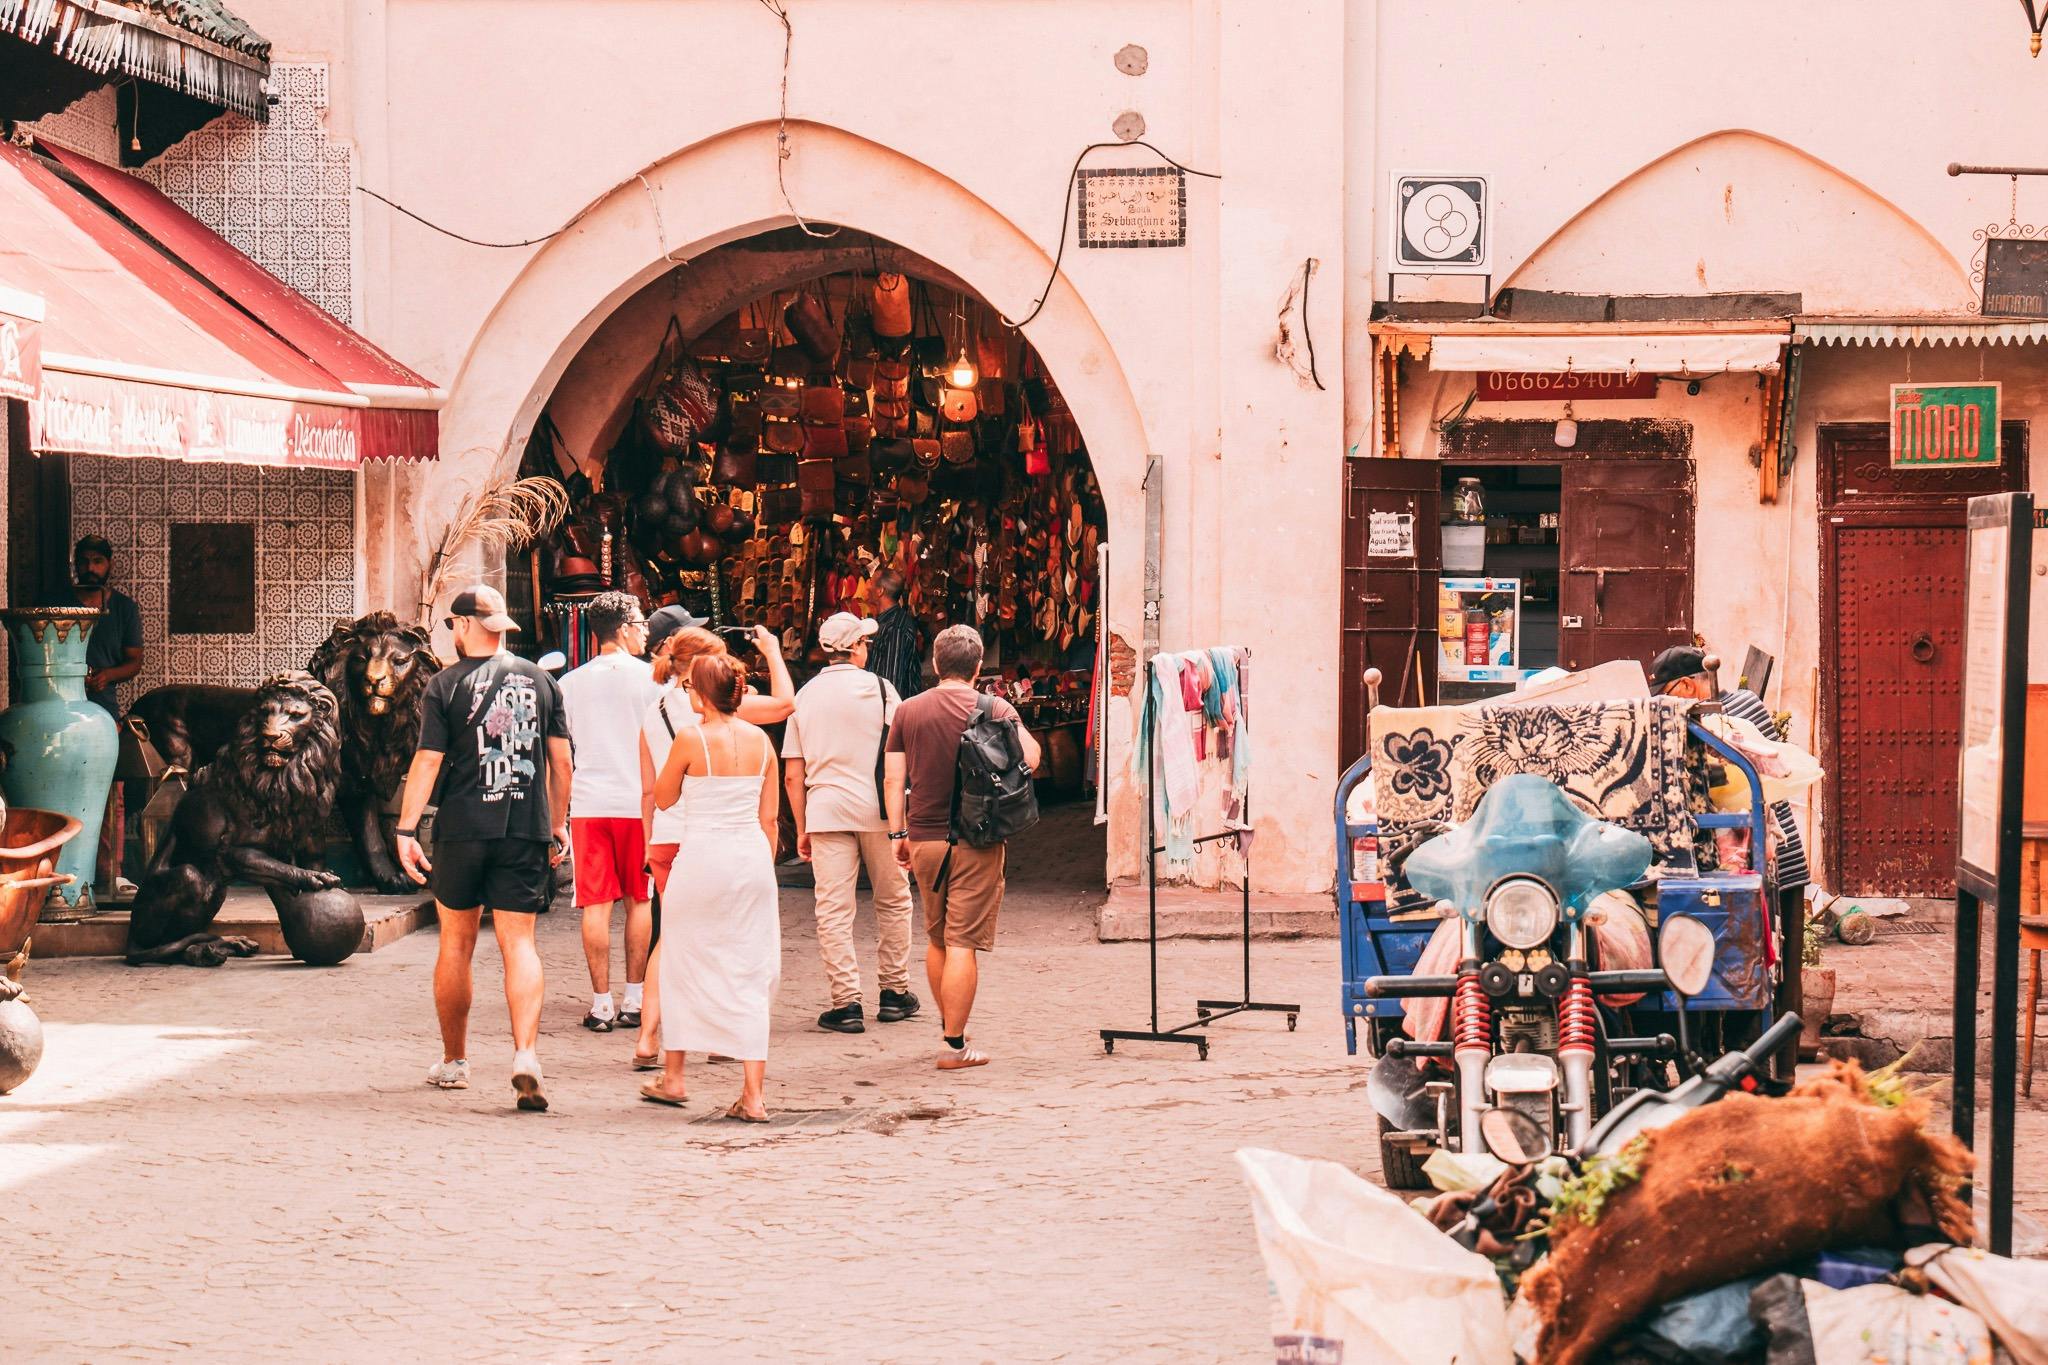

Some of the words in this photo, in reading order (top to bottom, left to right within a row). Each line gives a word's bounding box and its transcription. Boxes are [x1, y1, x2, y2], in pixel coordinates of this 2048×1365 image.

[1101, 212, 1165, 228] Sebbaghine
[294, 412, 356, 462] Décoration
[1895, 403, 1980, 461] MORO
[1370, 538, 1387, 546] Agua
